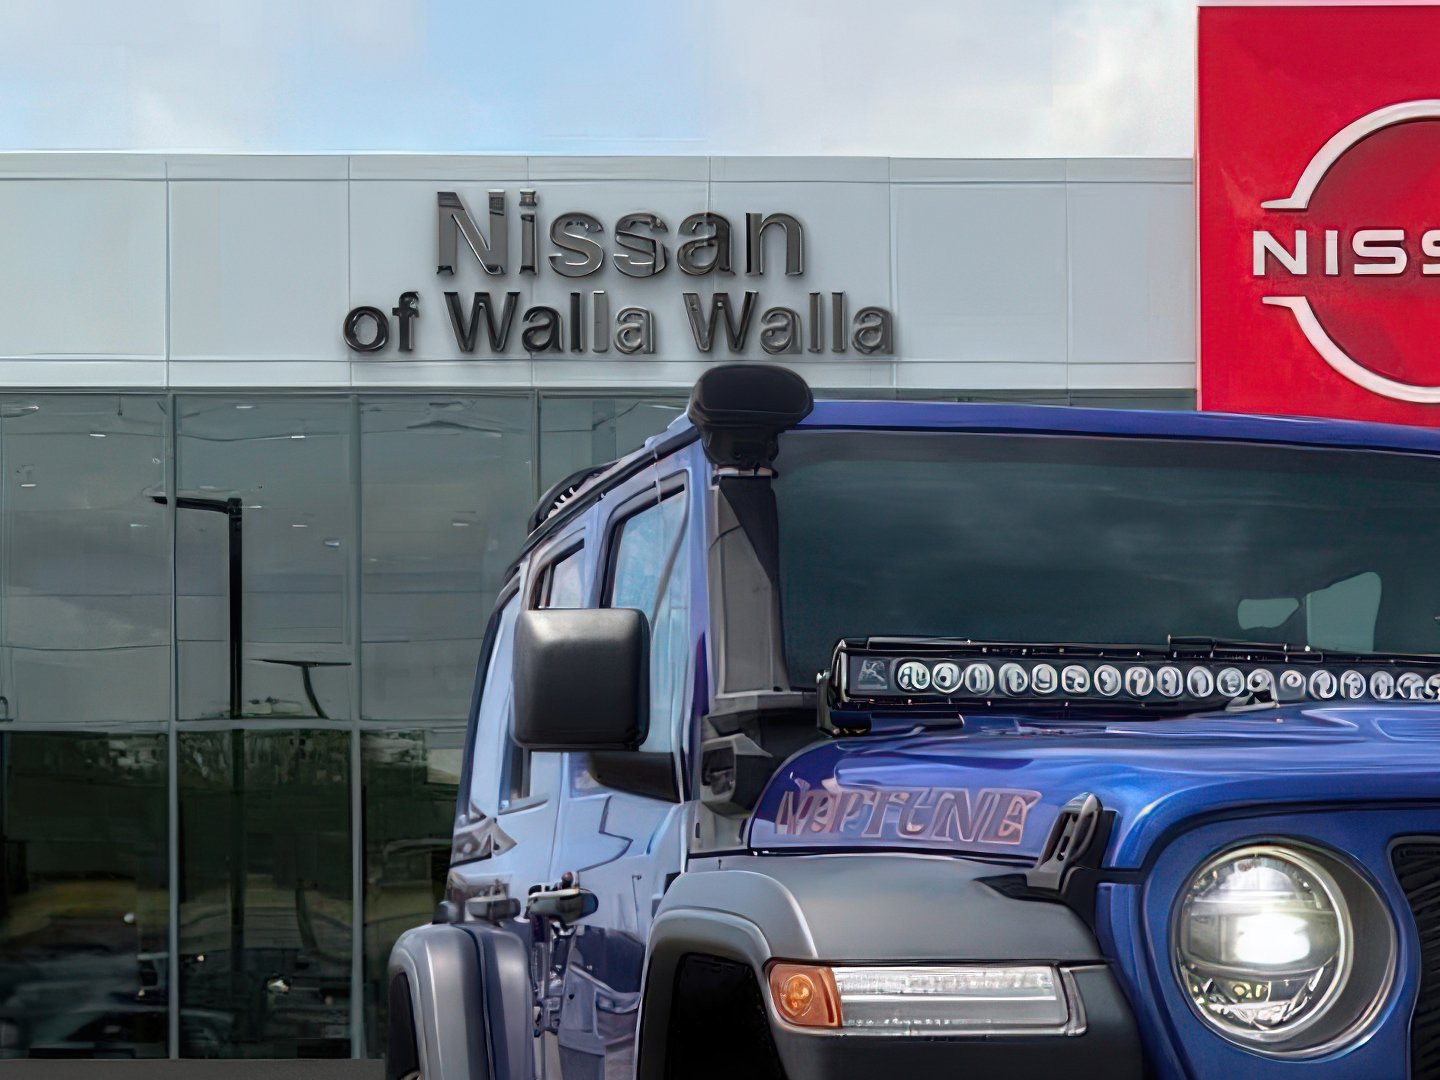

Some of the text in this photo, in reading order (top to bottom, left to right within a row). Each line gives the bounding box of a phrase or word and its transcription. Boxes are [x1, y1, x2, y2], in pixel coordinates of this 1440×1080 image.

[436, 189, 805, 277] Nissan
[342, 291, 894, 354] of Walla Walla
